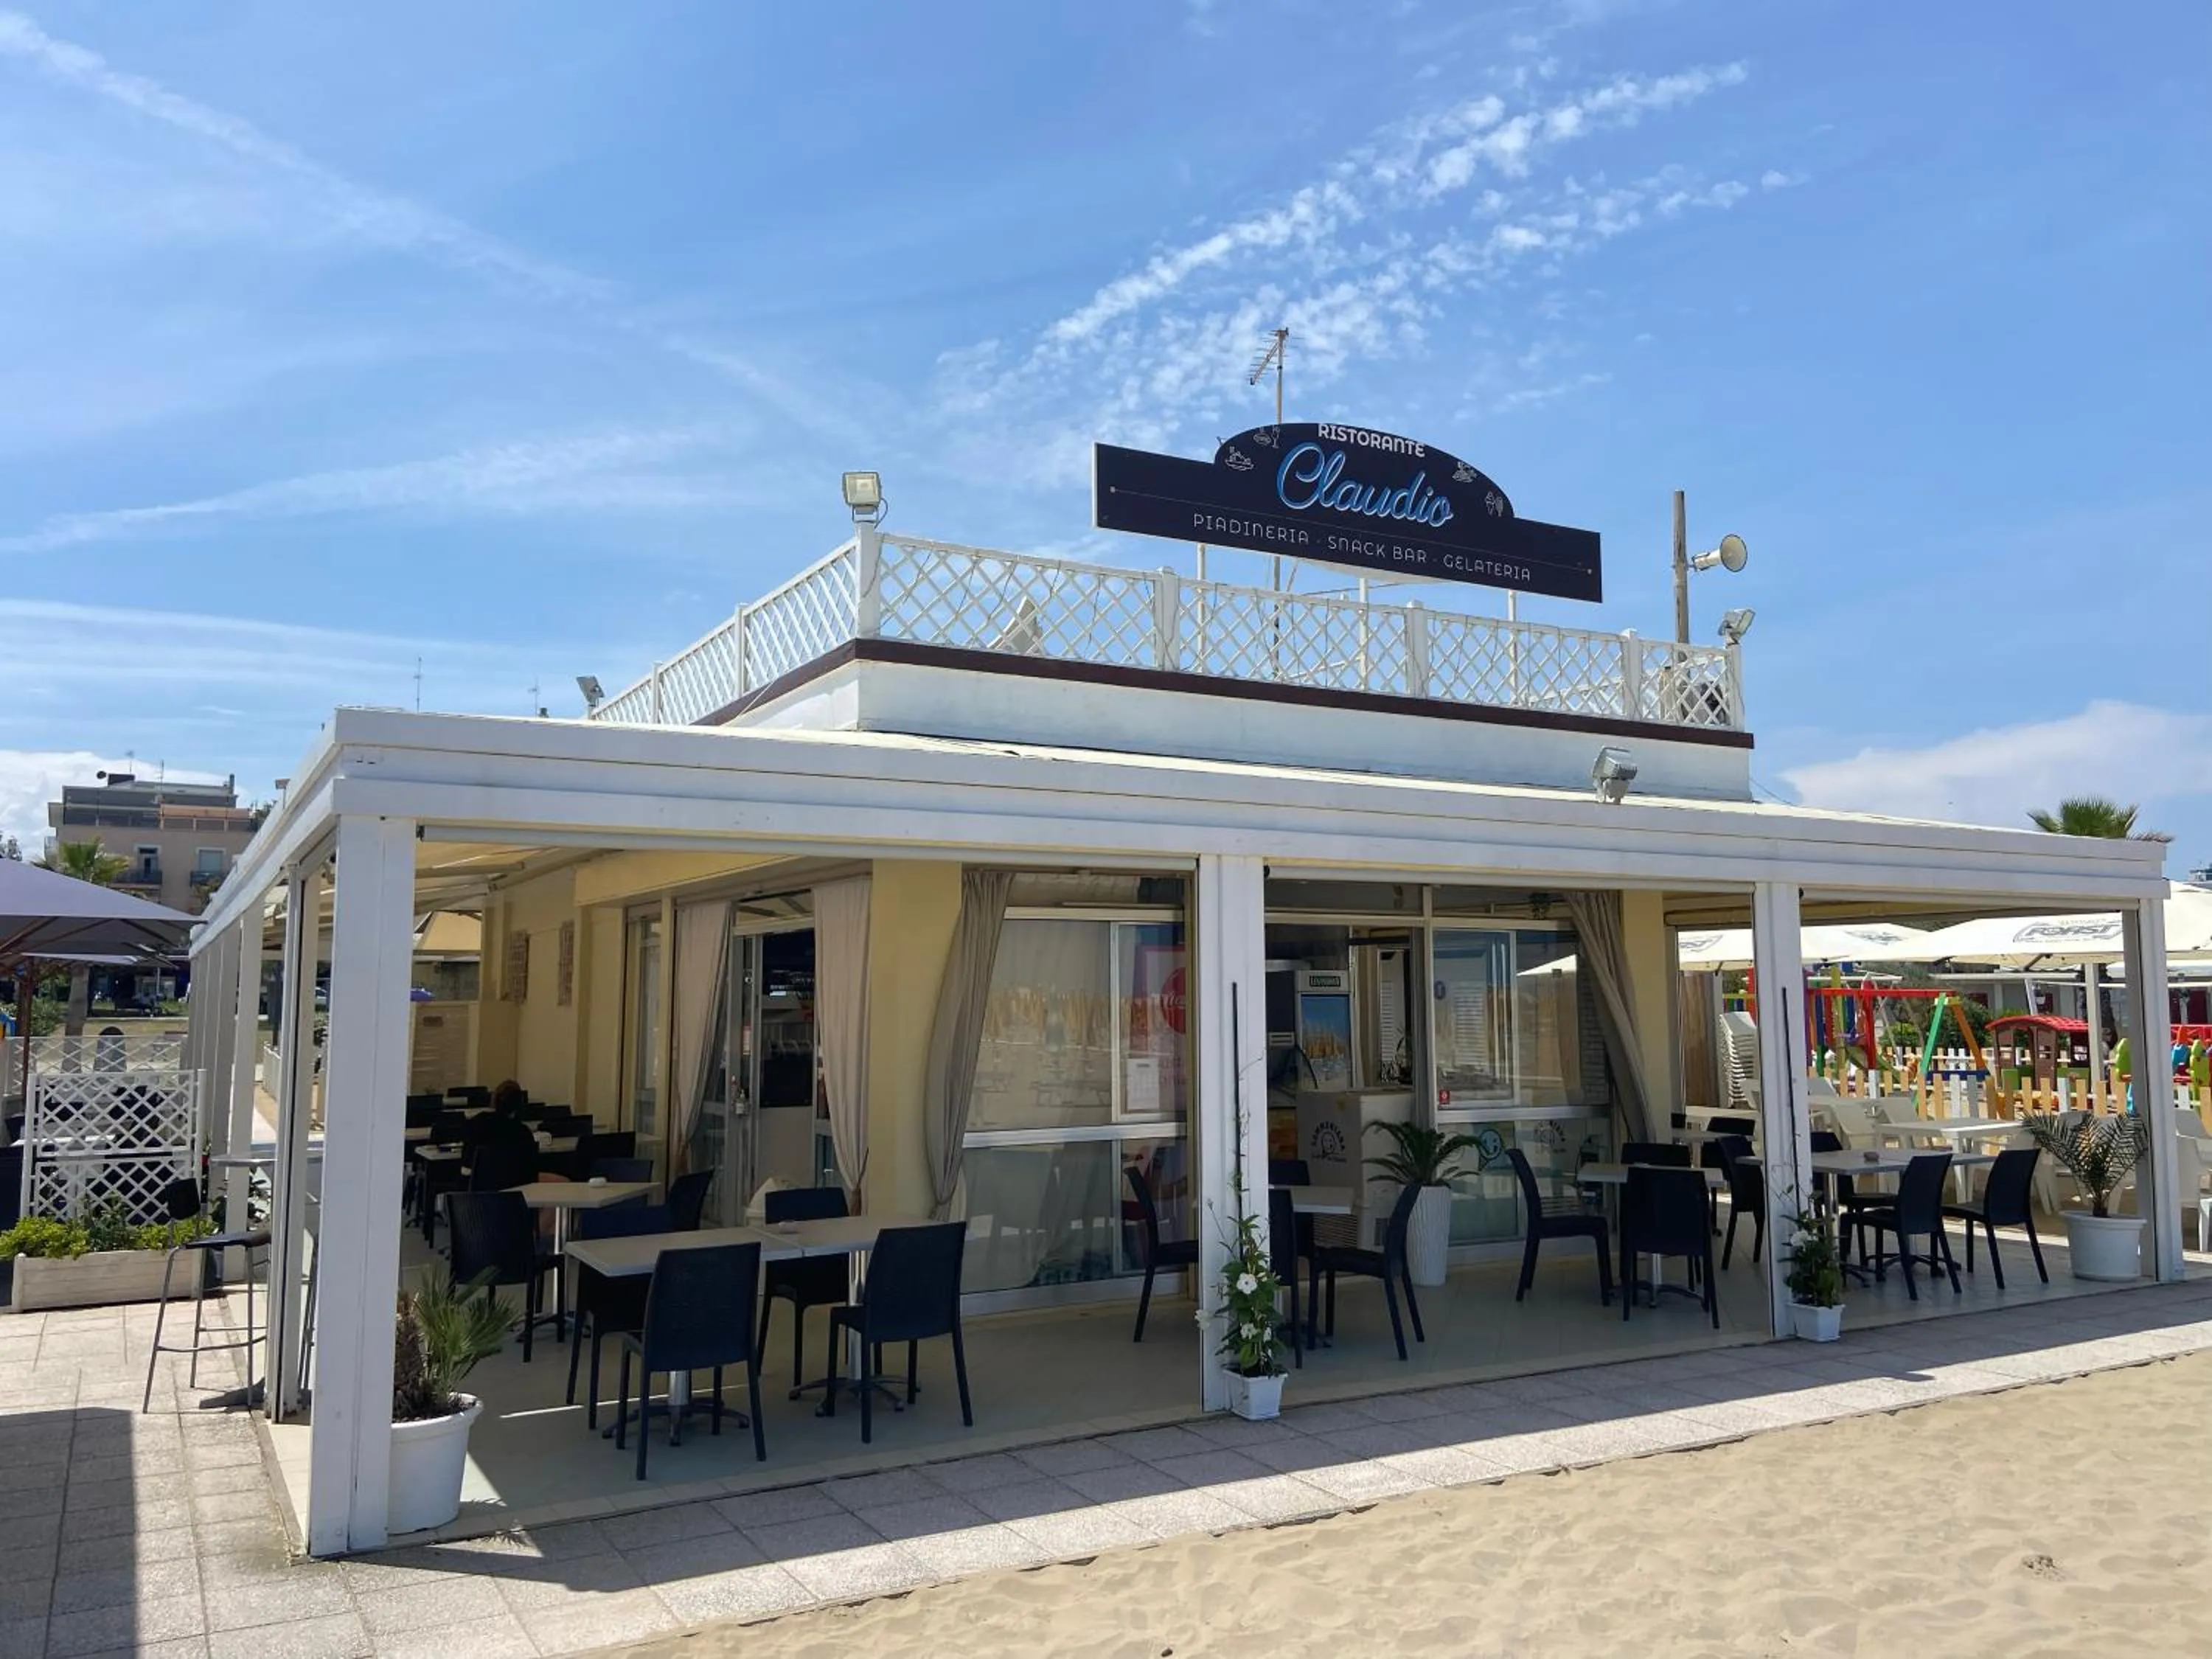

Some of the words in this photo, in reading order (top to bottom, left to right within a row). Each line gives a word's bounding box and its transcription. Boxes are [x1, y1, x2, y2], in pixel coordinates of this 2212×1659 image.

[1318, 423, 1425, 457] RISTORANTE
[1276, 442, 1454, 527] Claudio
[1193, 513, 1310, 545] PIADINERIA
[1328, 536, 1386, 558] SNACK
[1393, 545, 1427, 563] BAR
[1442, 553, 1531, 582] GELATERIA
